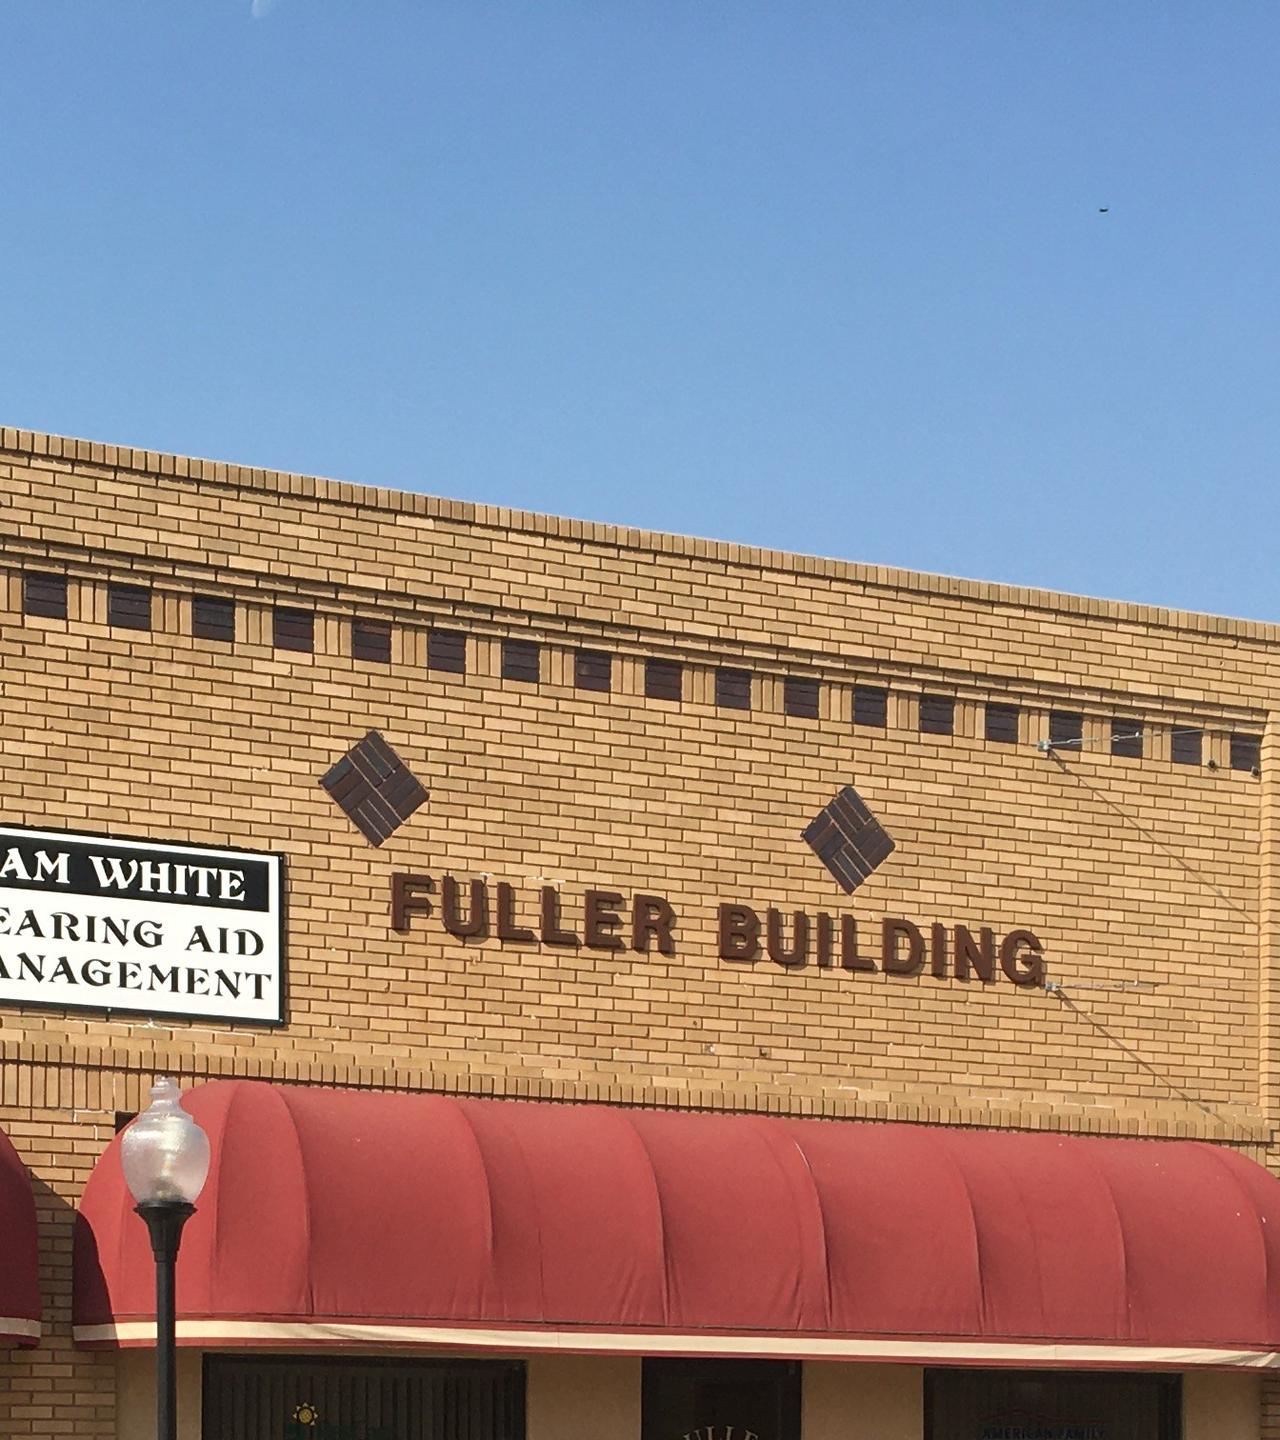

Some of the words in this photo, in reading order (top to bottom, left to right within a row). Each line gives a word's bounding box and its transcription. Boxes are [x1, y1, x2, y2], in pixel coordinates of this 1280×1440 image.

[88, 854, 247, 902] WHITE
[185, 924, 265, 956] AID
[390, 871, 677, 955] FULLER
[718, 901, 1046, 987] BUILDING
